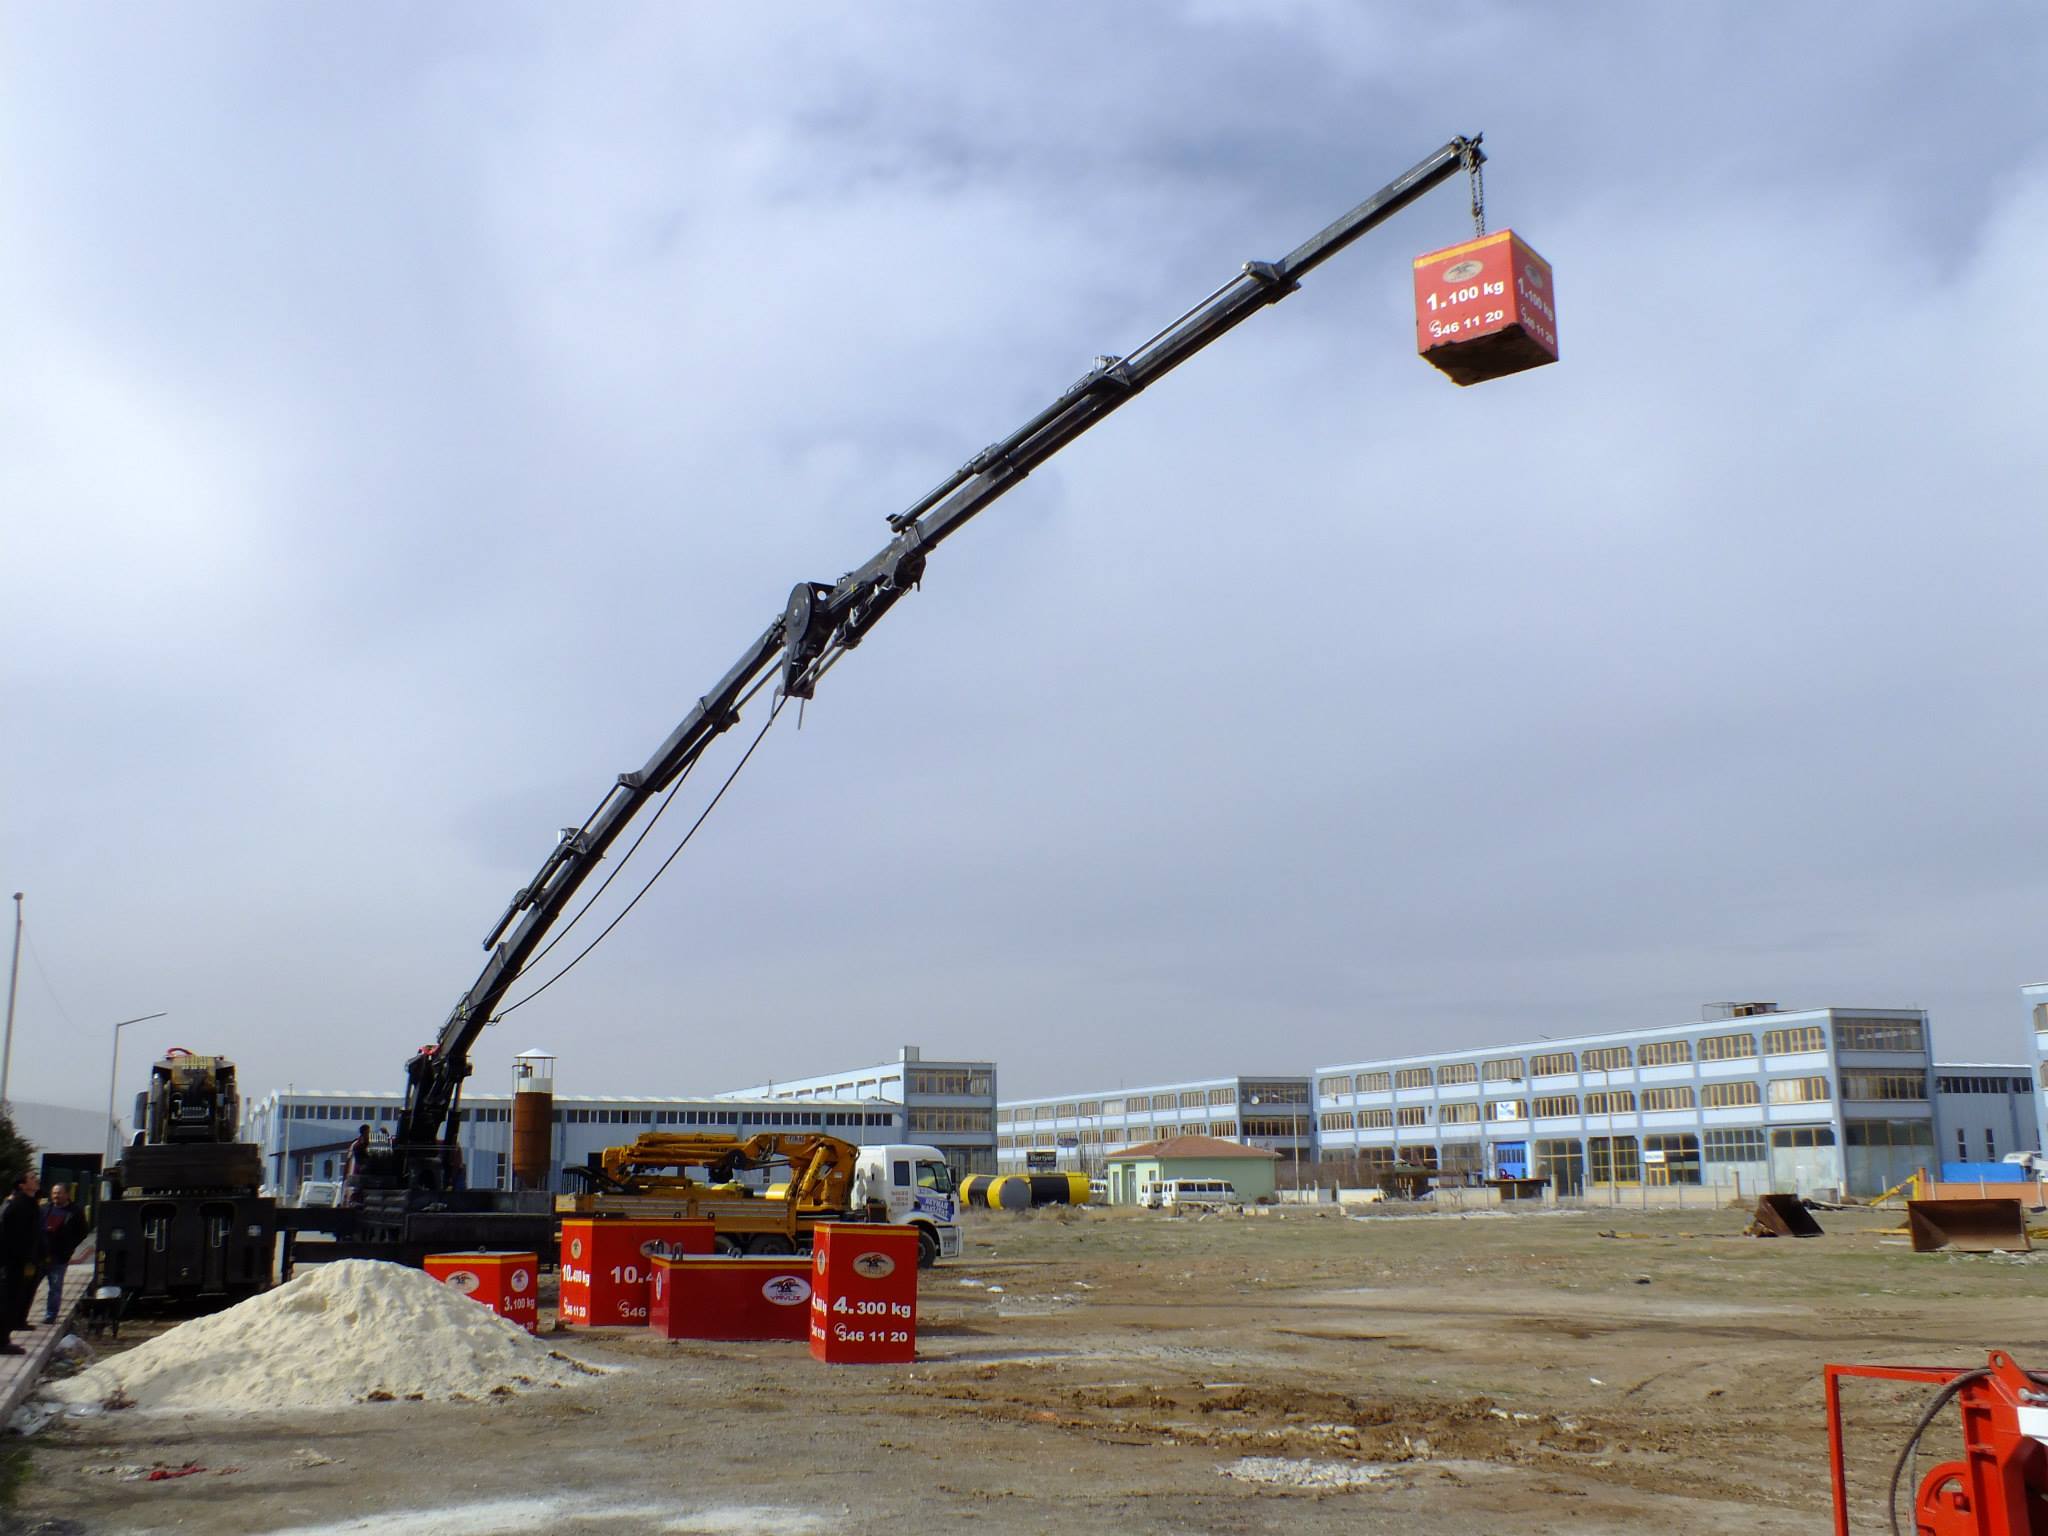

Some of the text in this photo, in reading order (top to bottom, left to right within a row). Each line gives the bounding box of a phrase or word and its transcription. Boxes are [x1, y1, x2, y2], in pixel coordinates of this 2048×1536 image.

[1427, 281, 1505, 311] 1.100 kg
[1433, 309, 1505, 338] 346 11 20
[621, 1307, 647, 1318] 346
[832, 1295, 887, 1315] 4.300
[891, 1302, 912, 1319] kg
[838, 1330, 865, 1342] 346
[869, 1331, 886, 1342] 11
[890, 1331, 909, 1343] 20
